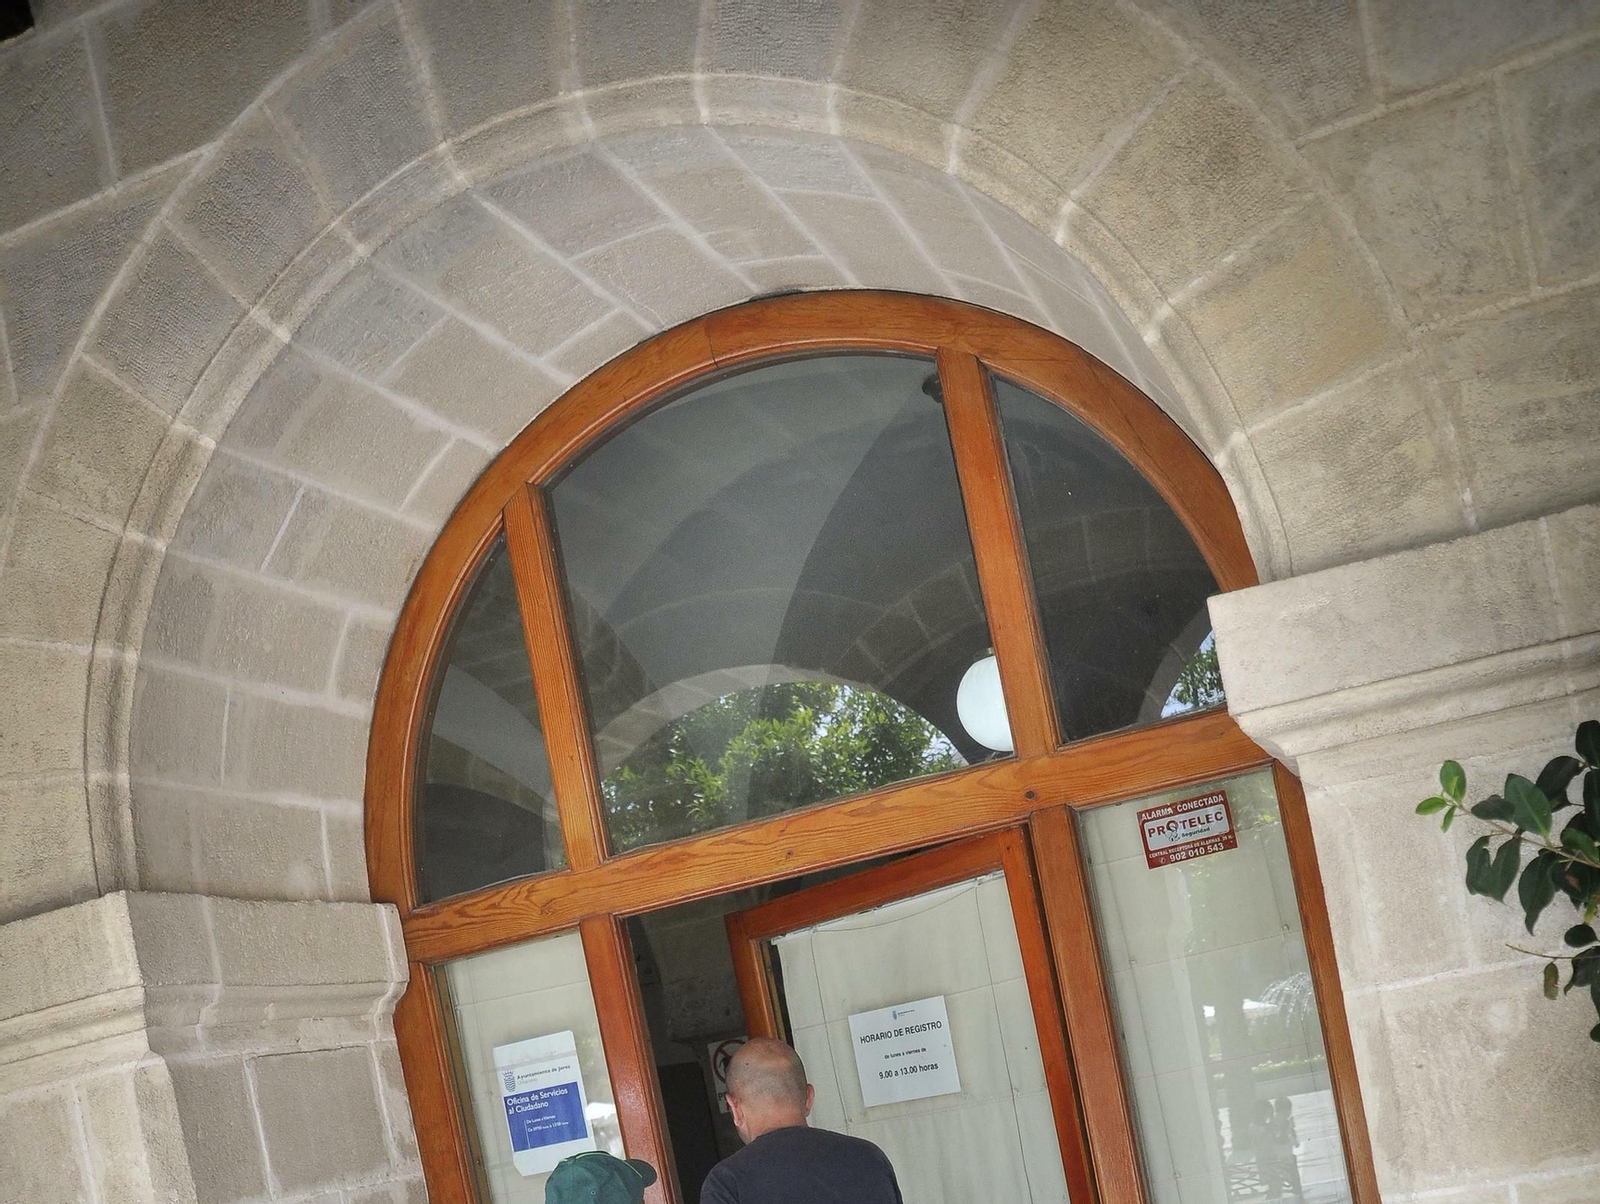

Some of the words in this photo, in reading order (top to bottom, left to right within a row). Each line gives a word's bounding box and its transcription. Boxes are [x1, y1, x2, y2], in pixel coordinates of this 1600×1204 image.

[1142, 807, 1173, 820] ALARMA
[1177, 794, 1224, 812] CONECTADA
[1148, 811, 1223, 837] PROTELEC
[1181, 827, 1210, 838] Seguridad
[1169, 852, 1187, 862] 902
[1188, 847, 1205, 857] 010
[1207, 843, 1224, 853] 543
[860, 1030, 892, 1044] HORARIO
[905, 1020, 942, 1035] REGISTRO
[879, 1070, 893, 1079] 9.00
[900, 1066, 918, 1076] 13.00
[919, 1062, 939, 1072] horas
[507, 1096, 530, 1106] Oficina
[540, 1088, 568, 1099] Servicios
[515, 1101, 549, 1113] Ciudadano
